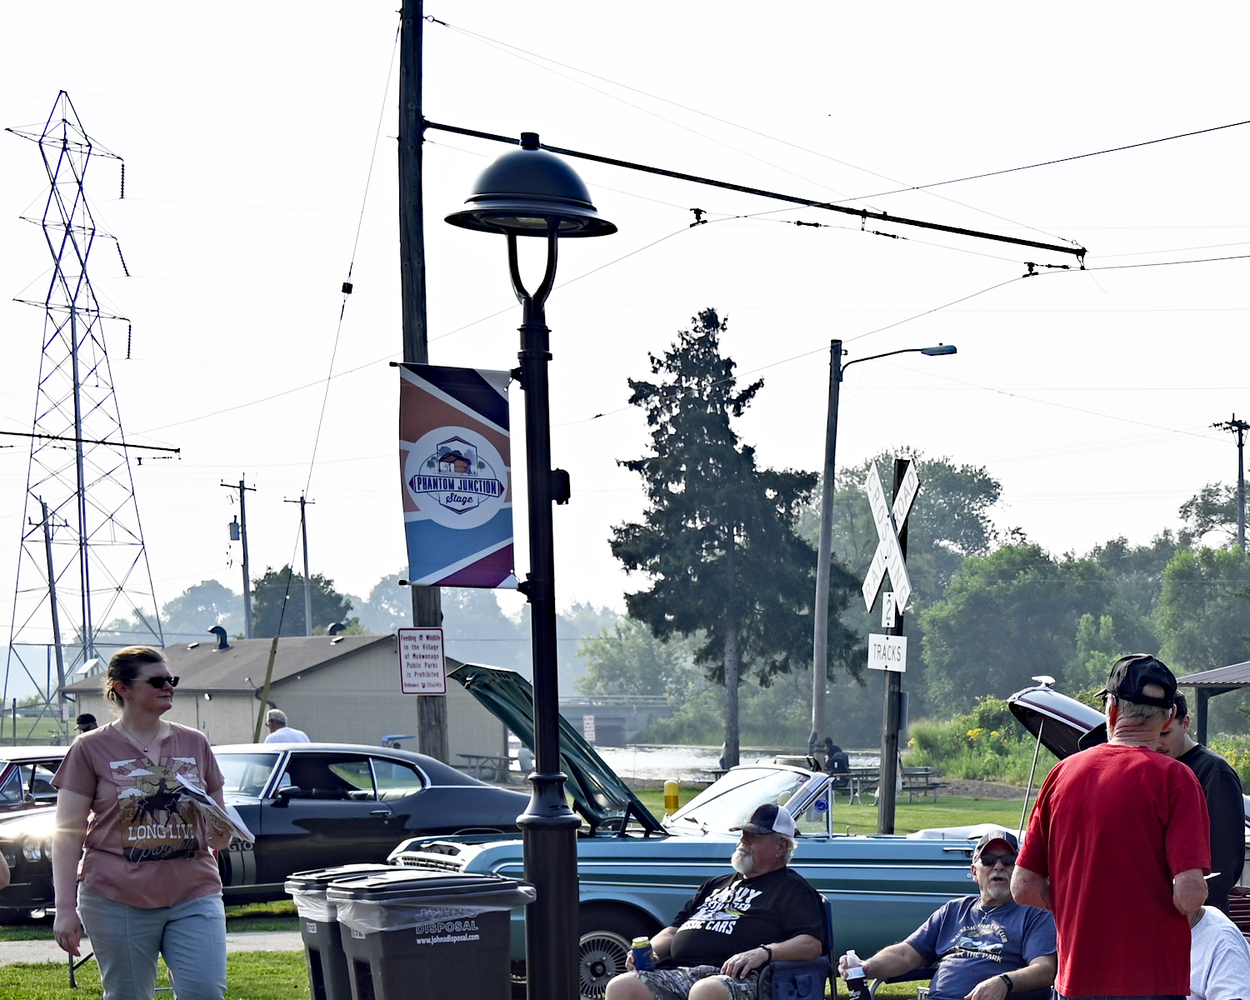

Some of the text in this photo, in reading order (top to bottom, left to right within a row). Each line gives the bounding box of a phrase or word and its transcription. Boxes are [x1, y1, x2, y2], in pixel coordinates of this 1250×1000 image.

[417, 477, 497, 495] PHANTOM JUNCTION
[445, 493, 474, 506] Stage
[868, 471, 907, 605] CROSSING
[864, 548, 887, 604] RAIL
[885, 599, 893, 620] 2
[400, 634, 417, 643] Feeding
[422, 643, 439, 652] Village
[873, 643, 902, 662] TRACKS
[412, 653, 439, 661] Mukwonago
[128, 824, 167, 841] LONG
[227, 841, 254, 852] GTO
[415, 920, 479, 935] DISPOSAL
[705, 920, 737, 935] CARS
[416, 933, 480, 946] www.johnsdisposal.com
[966, 951, 980, 959] THE
[981, 952, 1003, 963] PARK
